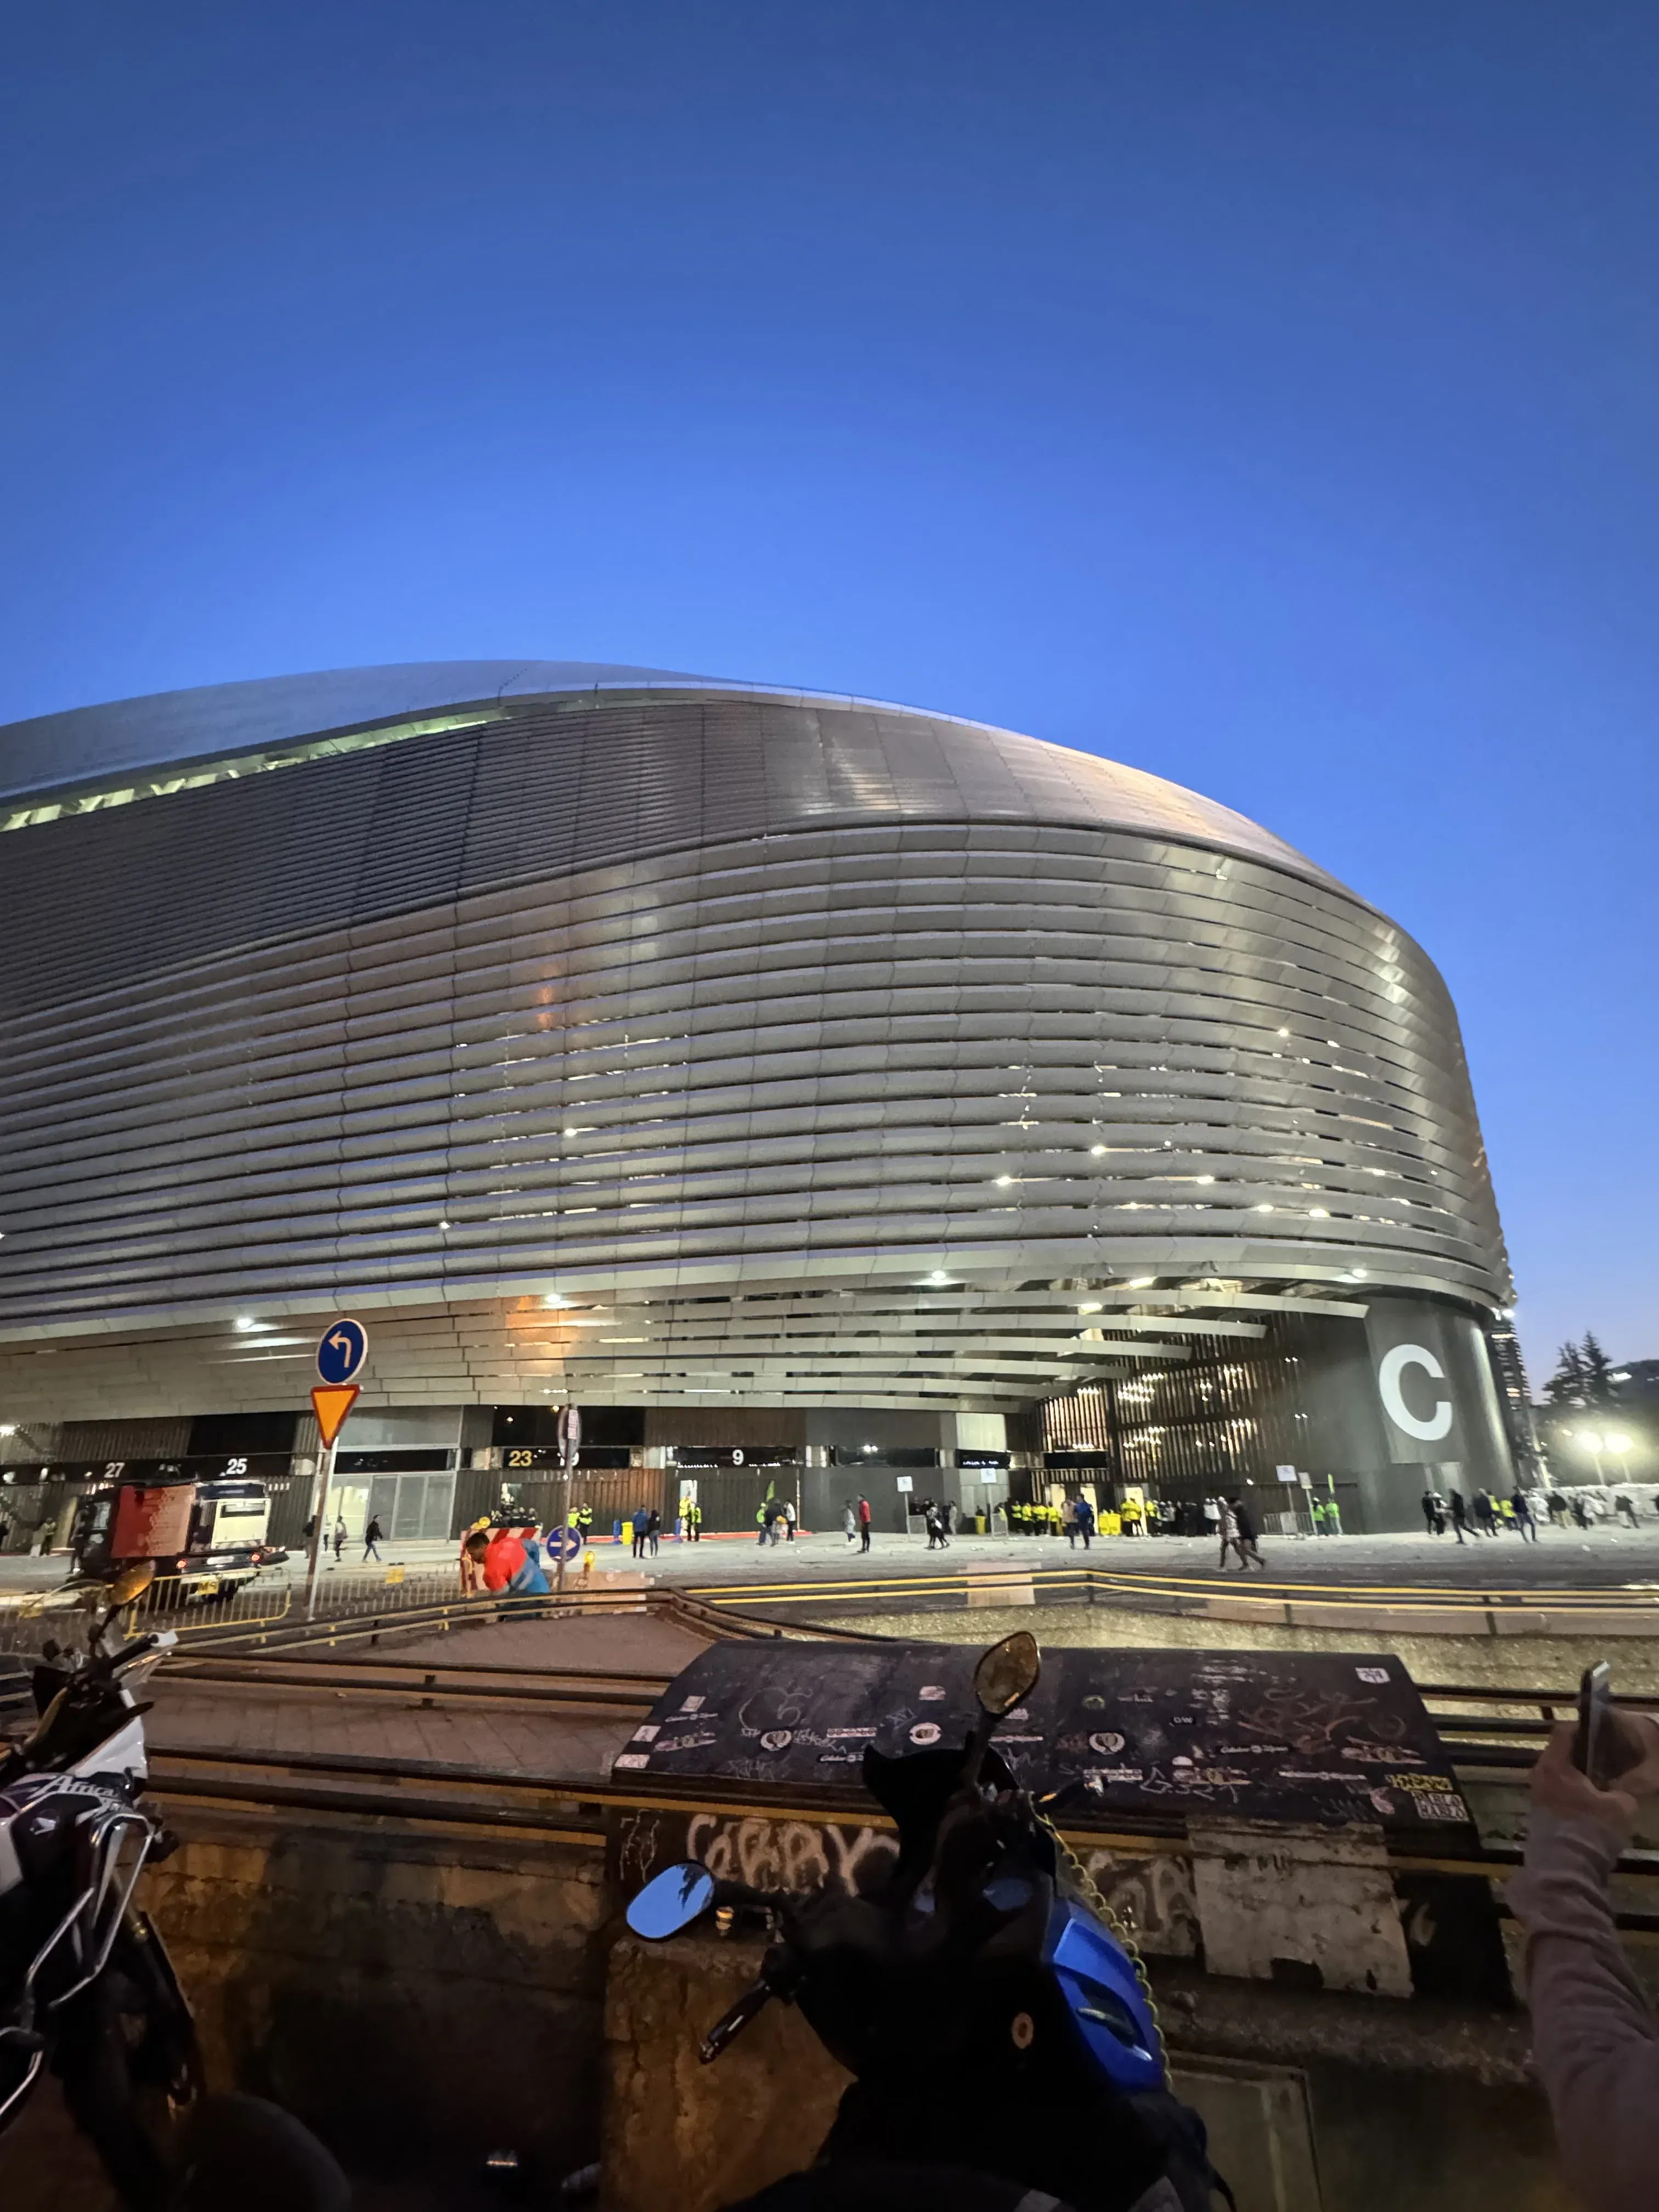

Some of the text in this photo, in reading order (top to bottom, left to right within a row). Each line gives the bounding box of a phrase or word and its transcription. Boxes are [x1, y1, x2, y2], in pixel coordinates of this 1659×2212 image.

[1379, 1344, 1453, 1440] C
[509, 1450, 532, 1466] 23
[732, 1449, 744, 1465] 9
[104, 1458, 247, 1478] 27 25
